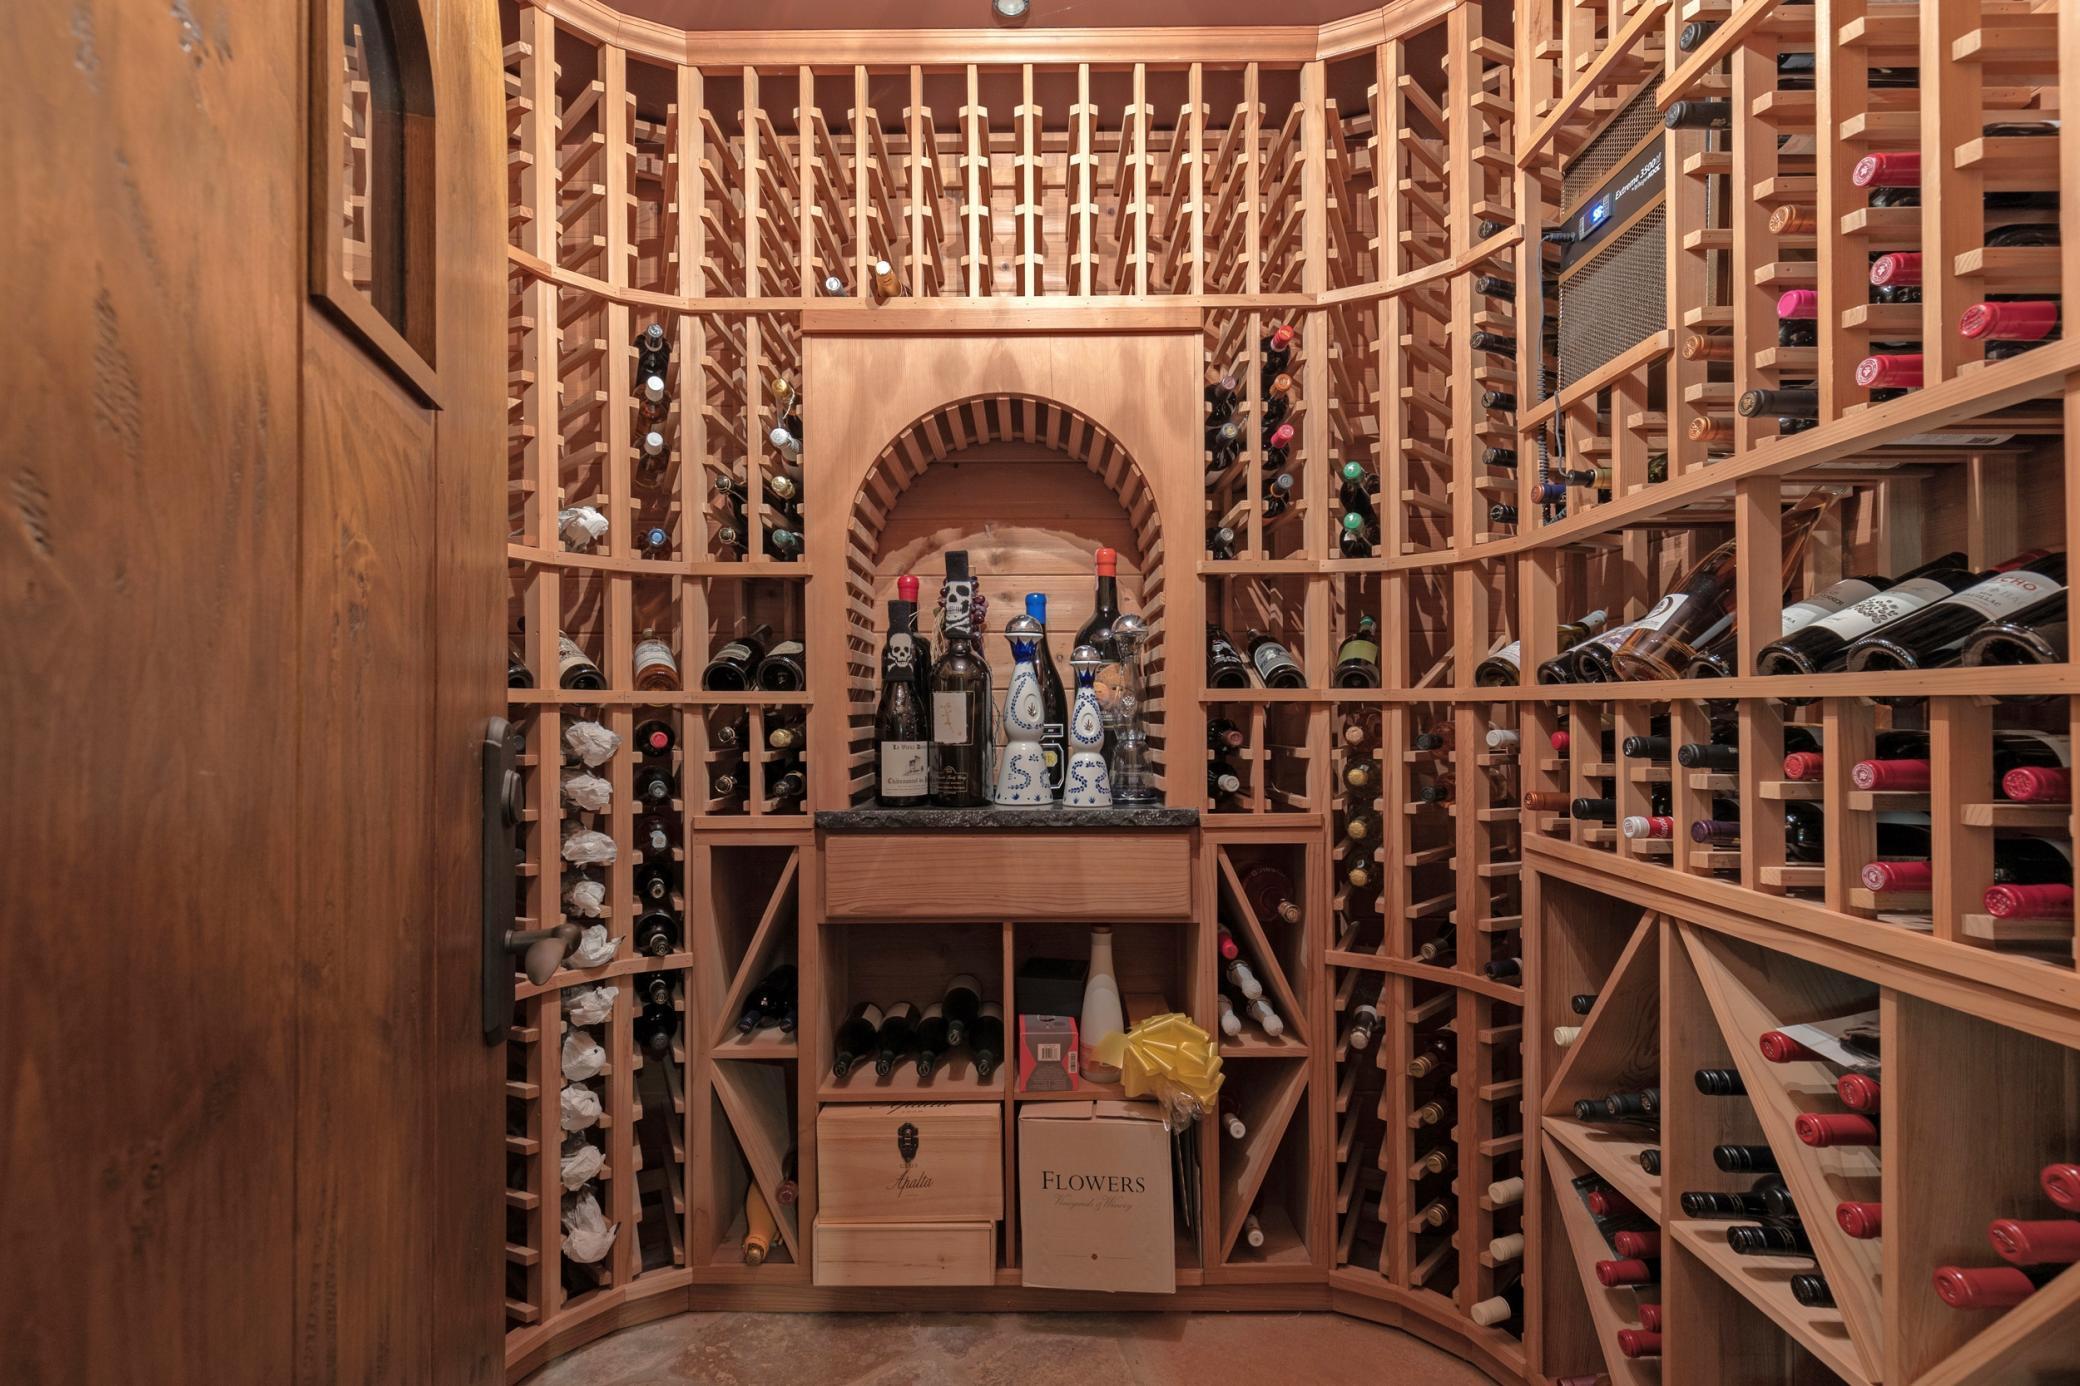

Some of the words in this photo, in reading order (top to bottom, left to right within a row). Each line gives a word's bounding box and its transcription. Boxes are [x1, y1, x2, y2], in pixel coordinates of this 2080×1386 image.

[1615, 174, 1640, 200] Extreme
[886, 1168, 935, 1198] Apalta
[1041, 1170, 1145, 1193] FLOWERS
